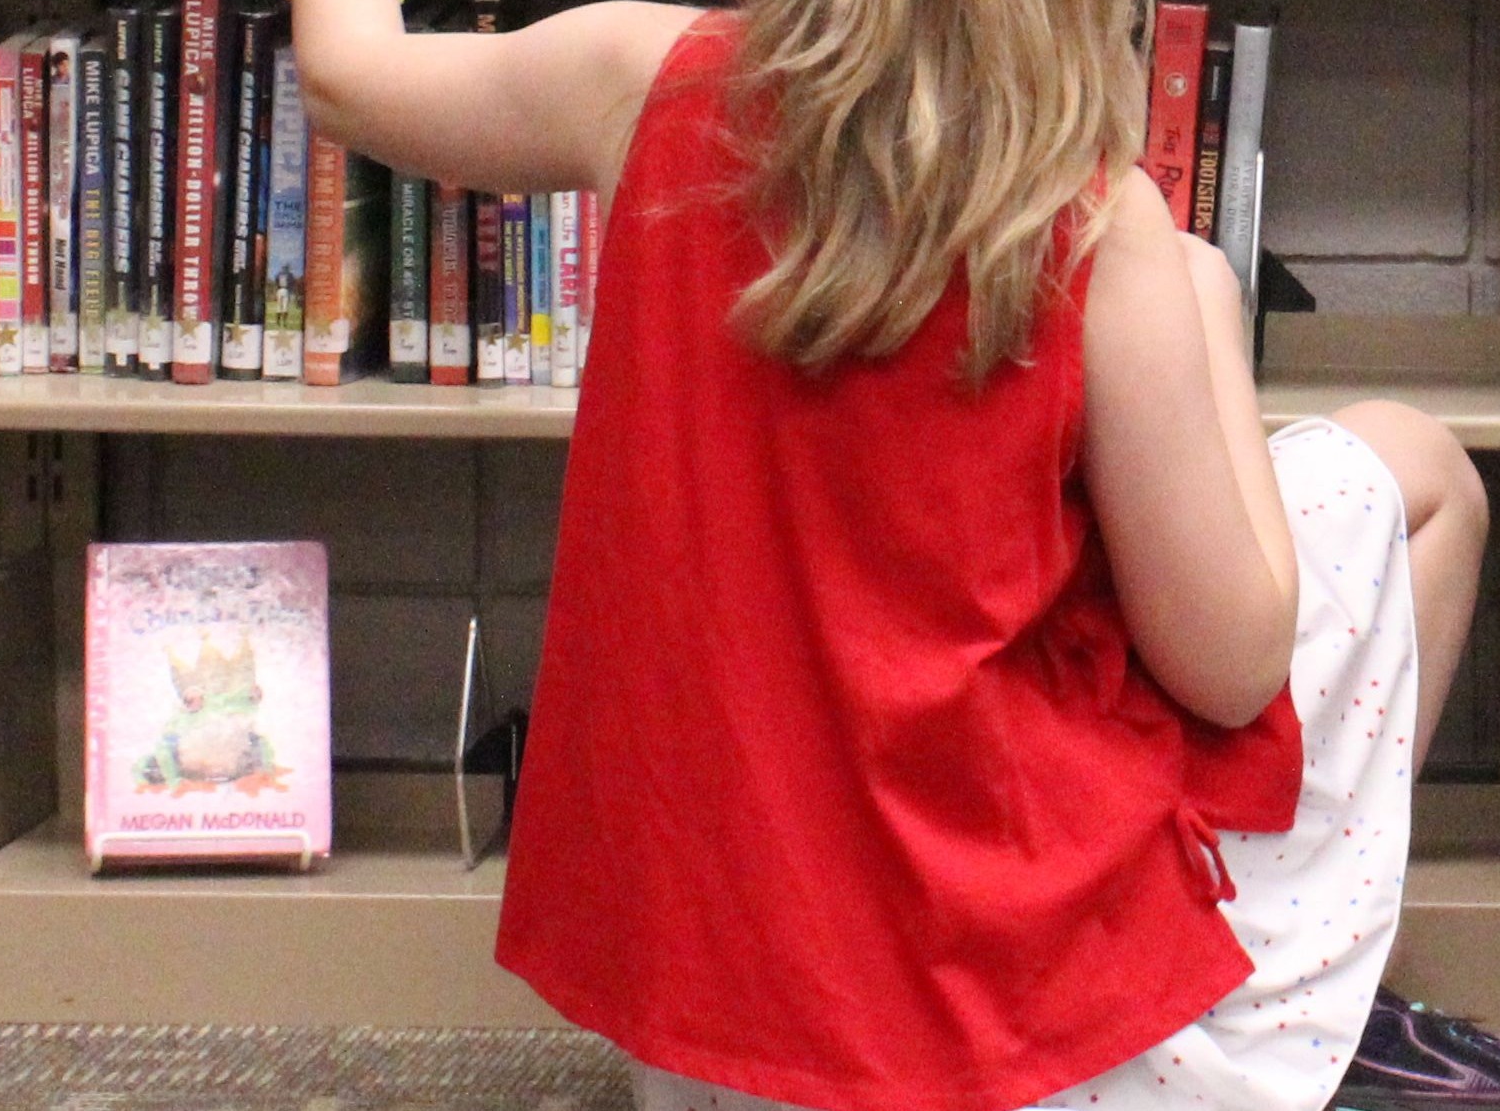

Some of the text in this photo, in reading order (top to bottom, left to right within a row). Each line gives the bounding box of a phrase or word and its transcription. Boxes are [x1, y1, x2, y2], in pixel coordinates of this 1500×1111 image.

[184, 1, 200, 76] LUPICA
[201, 16, 215, 60] MIKE
[86, 61, 100, 175] MIKE LUPICA
[114, 70, 131, 273] GAME CHANGERS
[182, 95, 204, 321] MILLION-DOLLAR THROW
[120, 812, 305, 832] MEGAN McDONALD
